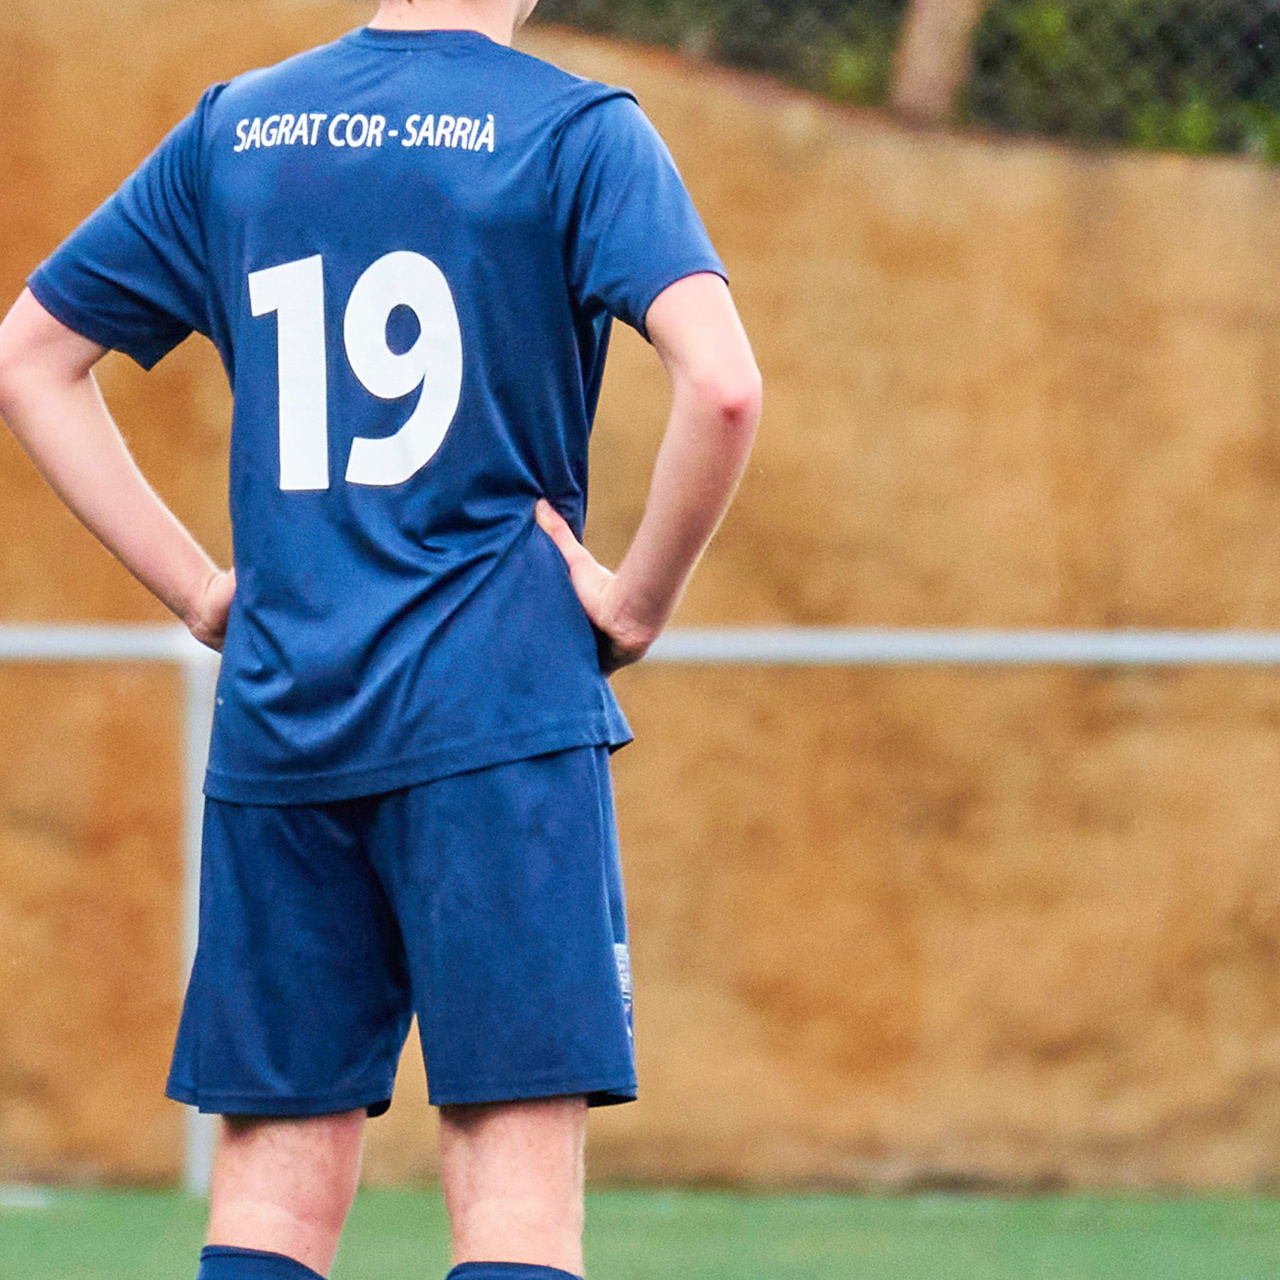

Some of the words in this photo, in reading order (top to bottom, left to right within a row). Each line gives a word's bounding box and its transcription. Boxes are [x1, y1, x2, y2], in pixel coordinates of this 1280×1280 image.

[233, 112, 328, 153] SAGRAT
[327, 112, 386, 148] COR
[401, 113, 496, 153] SARRIÀ
[248, 250, 463, 491] 19
